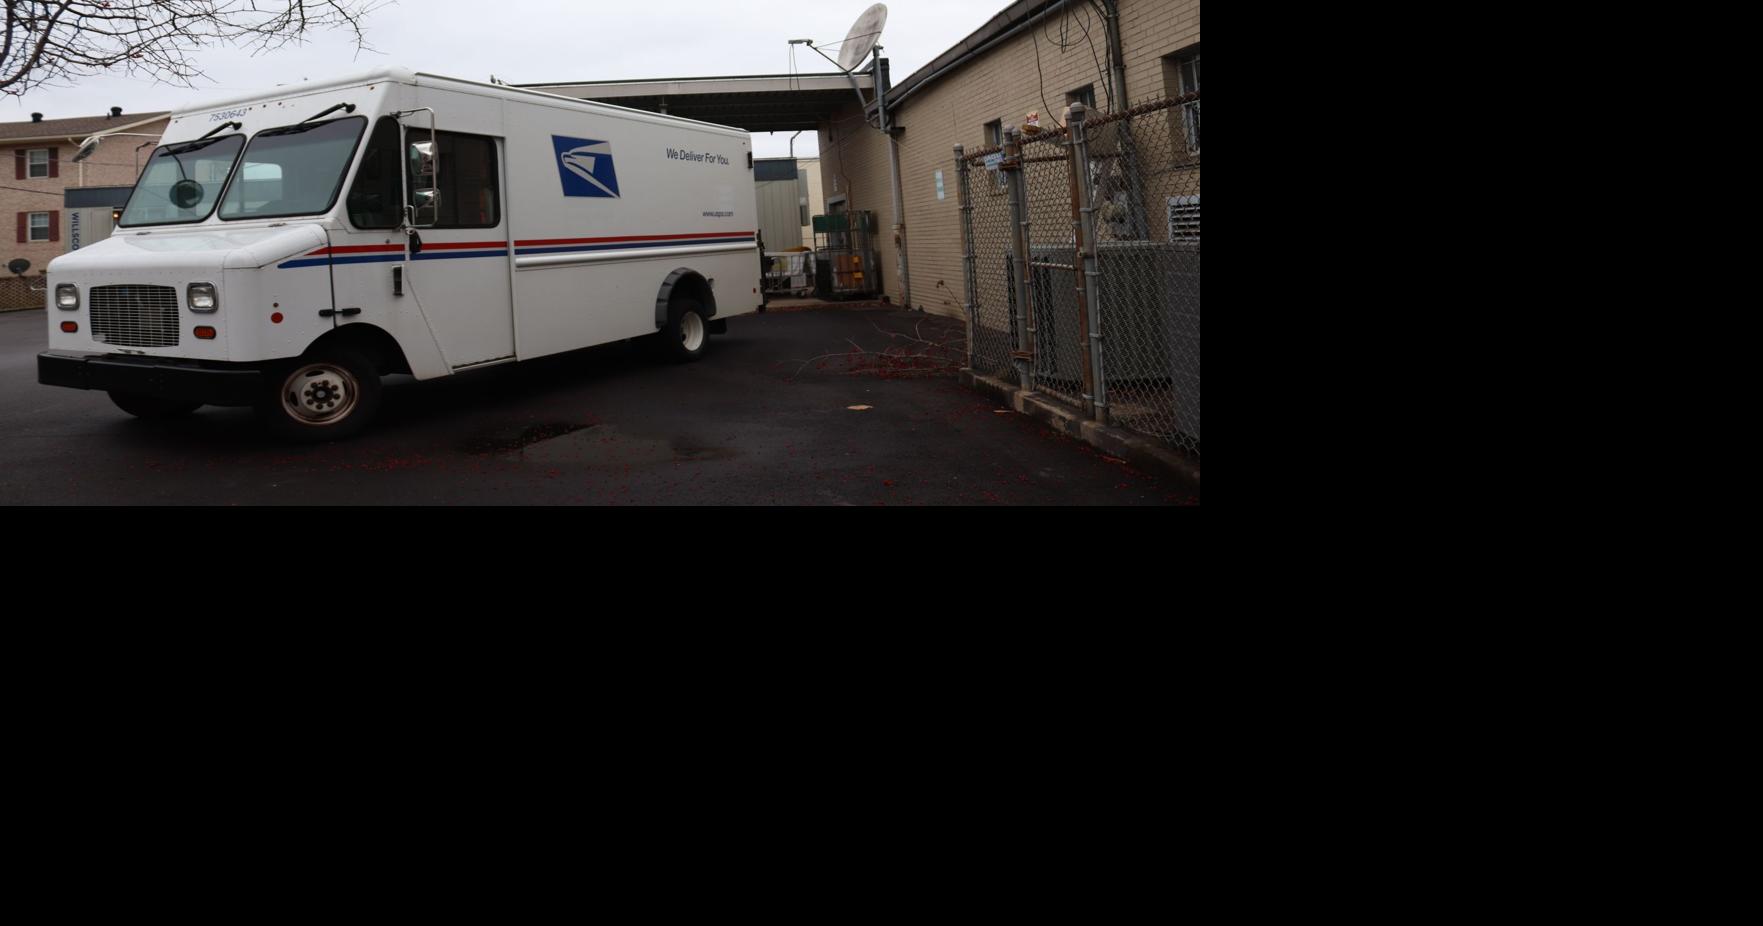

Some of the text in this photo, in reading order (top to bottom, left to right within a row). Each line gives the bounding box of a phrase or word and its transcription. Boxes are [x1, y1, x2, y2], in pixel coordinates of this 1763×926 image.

[209, 108, 247, 121] 7530643
[666, 147, 678, 160] We
[679, 149, 704, 162] Deliver
[705, 152, 716, 163] For
